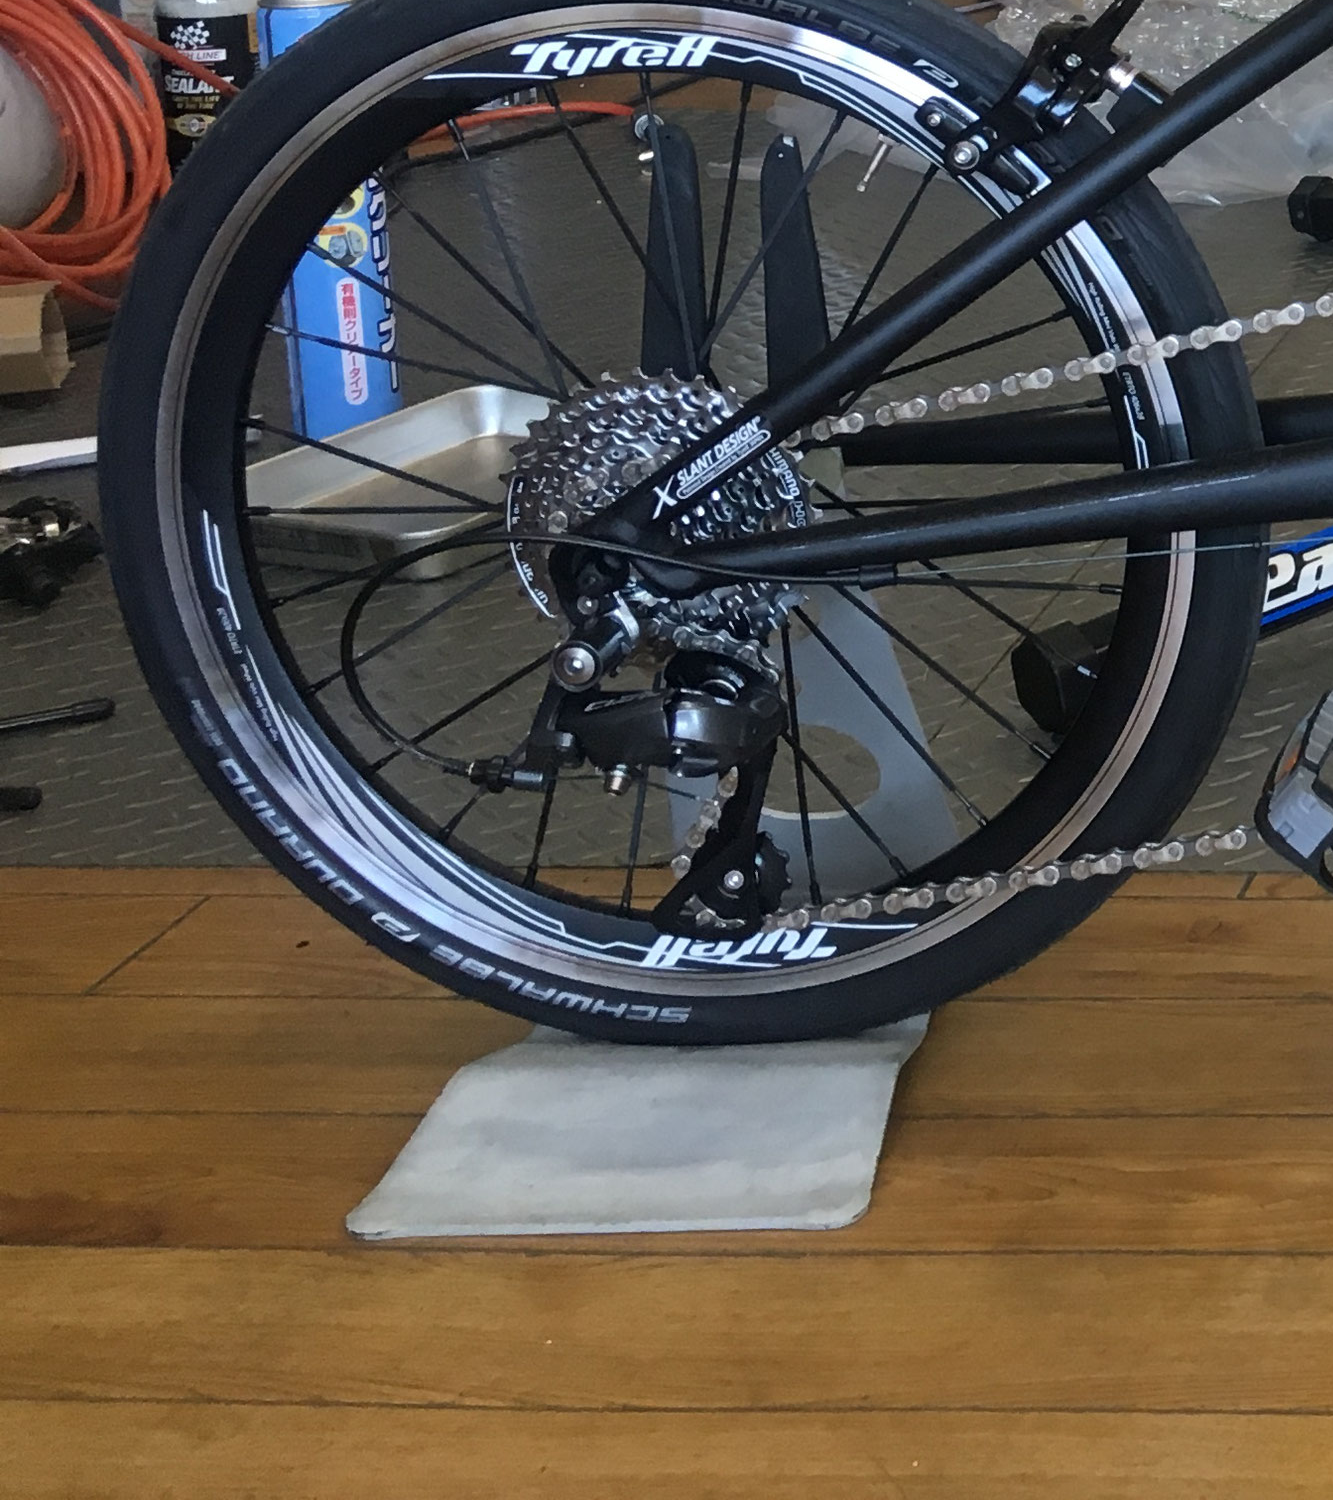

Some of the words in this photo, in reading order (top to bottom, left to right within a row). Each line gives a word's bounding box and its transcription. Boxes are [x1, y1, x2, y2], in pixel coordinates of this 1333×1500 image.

[196, 50, 221, 61] LINE
[511, 32, 719, 75] Tyrell
[677, 446, 717, 487] SLANT
[218, 757, 364, 905] DURANO
[429, 943, 693, 1025] SCHWALBE
